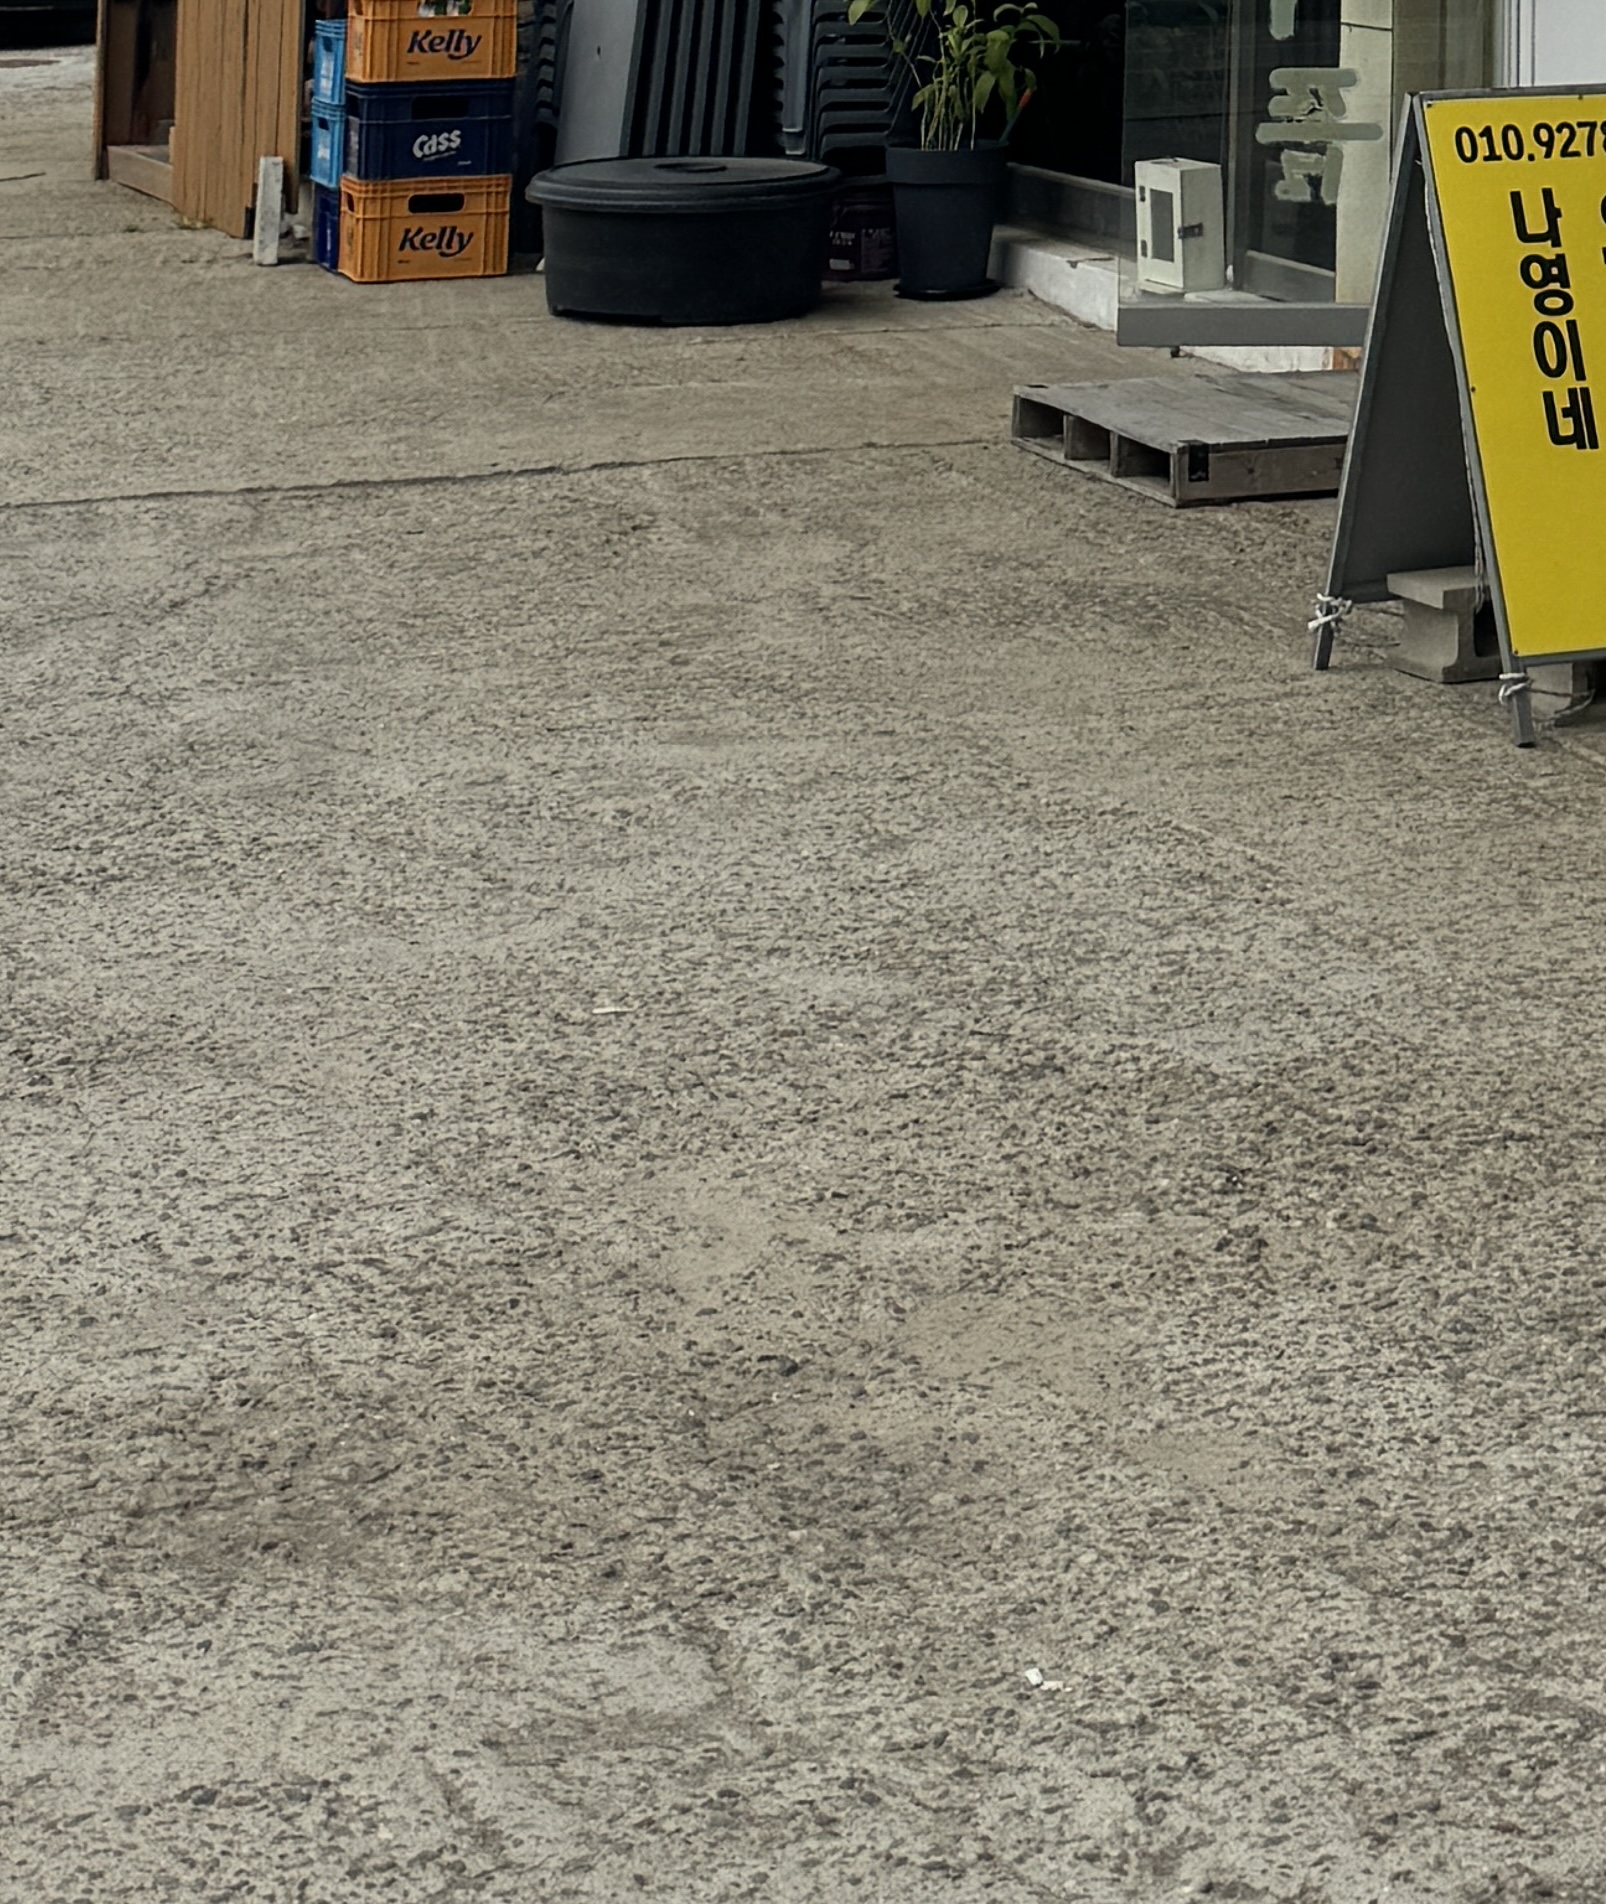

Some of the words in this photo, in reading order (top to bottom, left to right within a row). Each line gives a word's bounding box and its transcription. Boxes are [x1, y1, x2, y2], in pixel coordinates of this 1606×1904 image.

[406, 28, 482, 60] Kelly
[398, 225, 474, 258] Kelly
[1509, 187, 1600, 451] 나영이네
